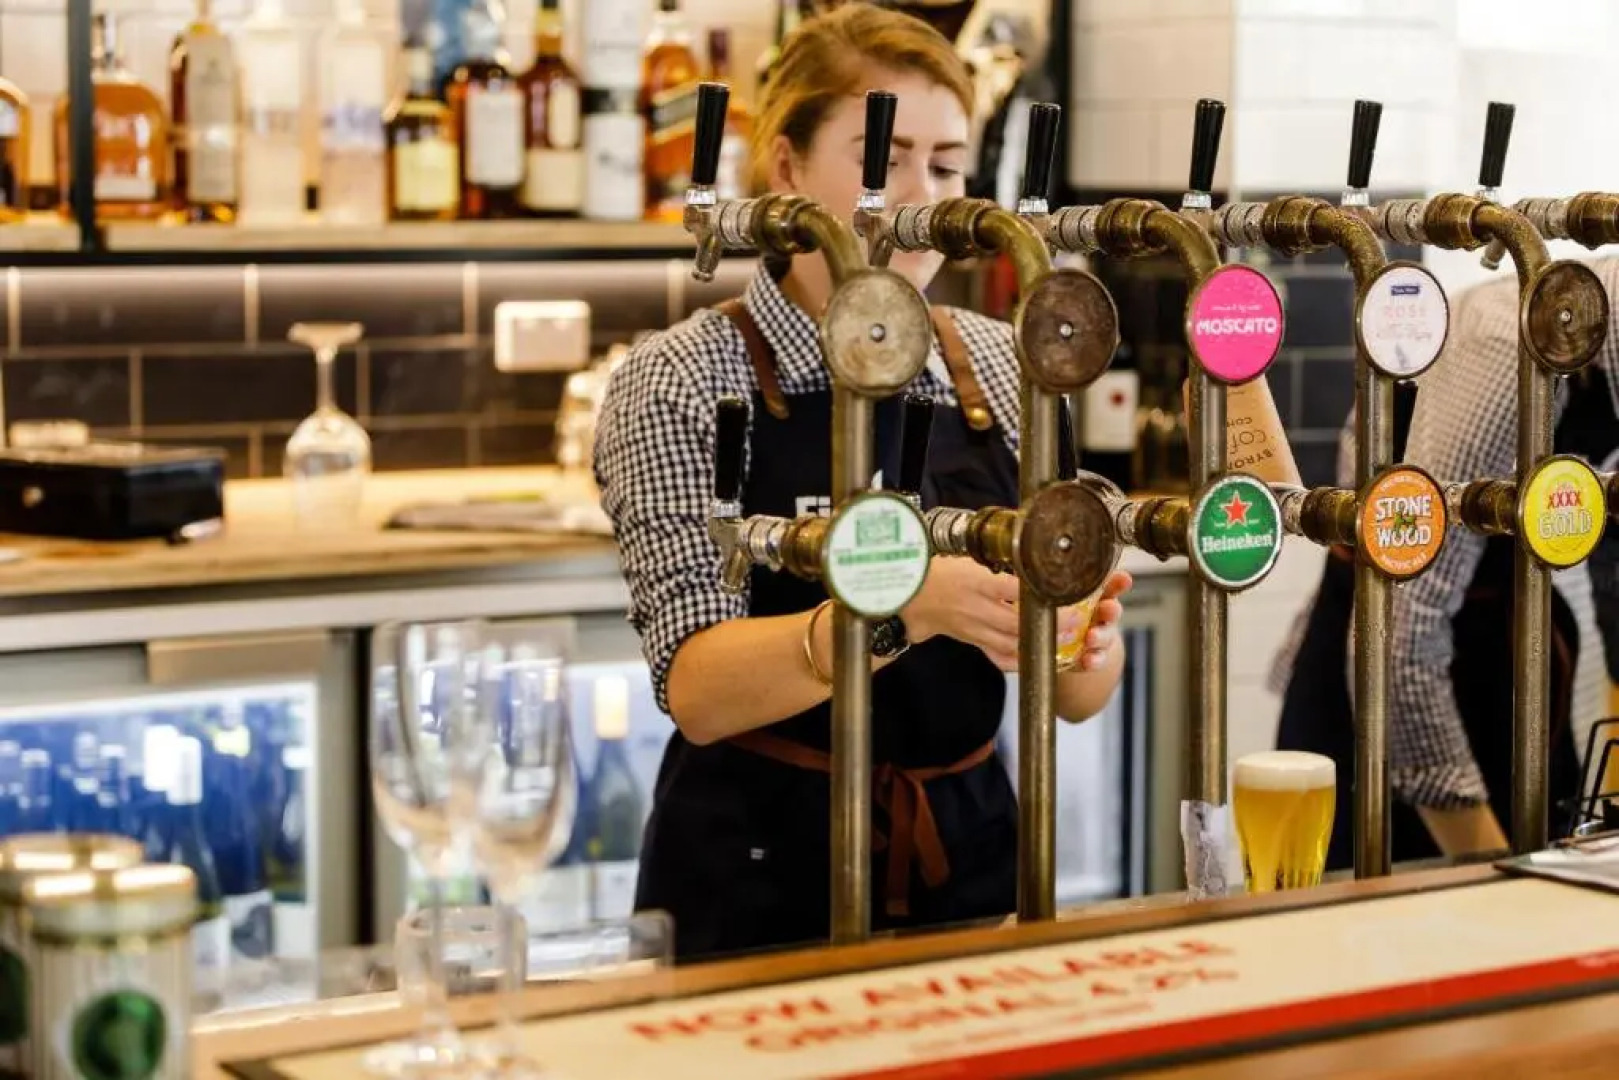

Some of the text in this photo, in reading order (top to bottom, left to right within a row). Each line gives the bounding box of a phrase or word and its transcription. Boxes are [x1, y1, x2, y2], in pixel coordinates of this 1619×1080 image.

[1196, 317, 1277, 335] MOSCATO
[1375, 494, 1433, 521] STONE
[1547, 490, 1583, 509] XXXX
[1377, 524, 1432, 549] WOOD
[1538, 509, 1593, 540] GOLD
[1202, 532, 1272, 554] Heineken
[863, 940, 1236, 1006] AVAILABLE
